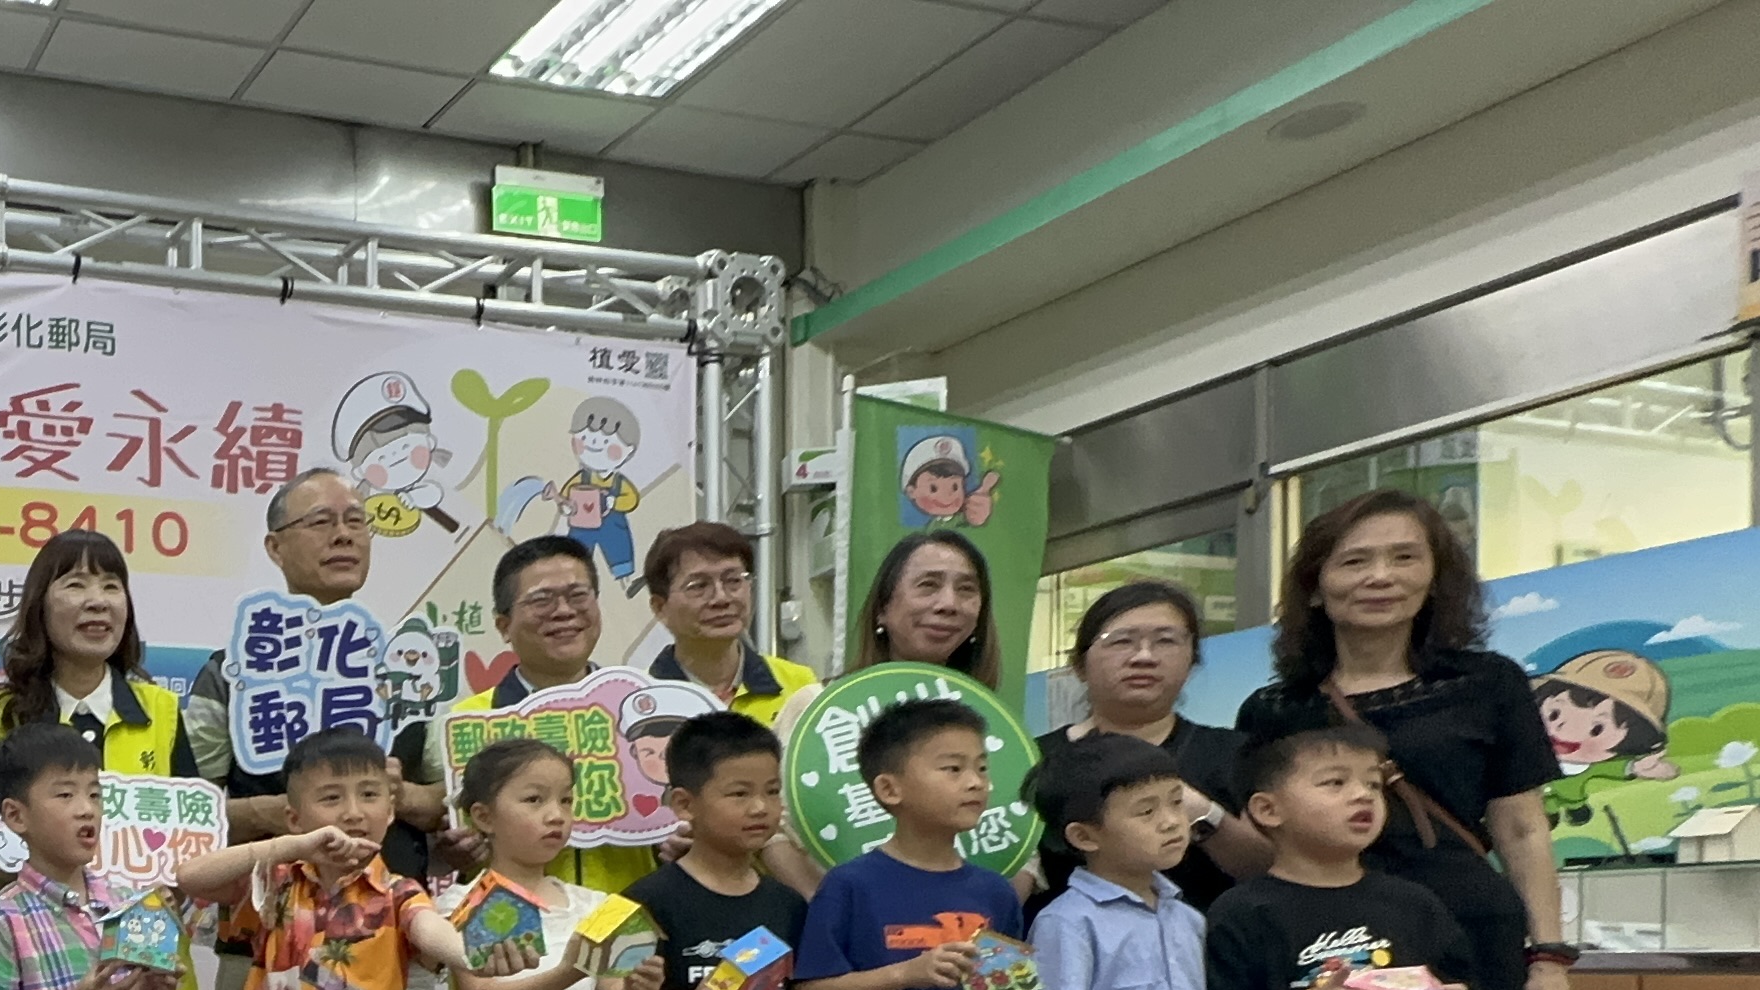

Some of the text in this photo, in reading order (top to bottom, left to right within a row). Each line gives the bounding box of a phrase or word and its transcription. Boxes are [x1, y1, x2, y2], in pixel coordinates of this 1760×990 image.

[245, 607, 372, 679] 彰化
[249, 685, 381, 755] 郵局
[102, 784, 216, 828] 政壽險
